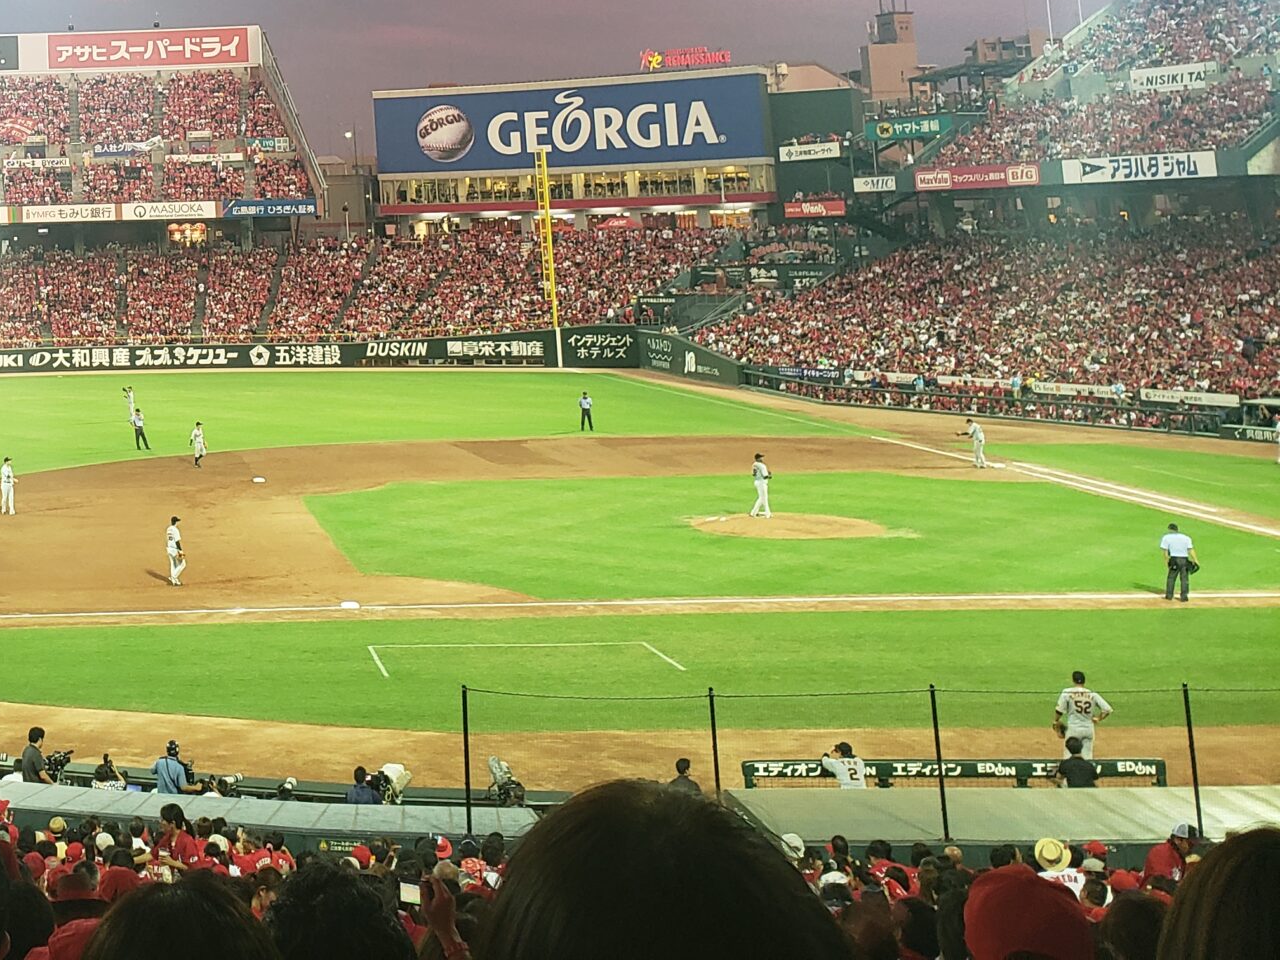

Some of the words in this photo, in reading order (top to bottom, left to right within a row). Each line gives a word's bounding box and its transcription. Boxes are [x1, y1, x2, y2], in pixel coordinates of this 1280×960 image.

[56, 36, 240, 63] アサヒスーパードライ
[1145, 74, 1184, 87] NISIKI
[418, 112, 465, 140] GEORGIA
[487, 90, 719, 155] GEORGIA
[1108, 156, 1159, 179] アヲハタ
[1163, 154, 1199, 176] ジャム
[870, 178, 894, 189] MIC
[919, 170, 949, 185] MaxValu
[31, 211, 56, 219] YMFG
[57, 207, 112, 219] もみじ銀行
[149, 204, 204, 214] MASUOKA
[232, 206, 264, 215] 広島銀行
[268, 204, 315, 215] ひろぎん証券
[568, 333, 634, 347] インテリジェント
[275, 345, 341, 365] 五洋建設
[366, 342, 428, 357] DUSKIN
[462, 340, 544, 357] 章栄不動産
[577, 347, 627, 359] ホテルズ
[52, 349, 131, 368] 大和興産
[1074, 700, 1092, 714] 52
[754, 762, 821, 777] エディオン
[847, 767, 860, 781] 2
[892, 762, 962, 777] エディオン
